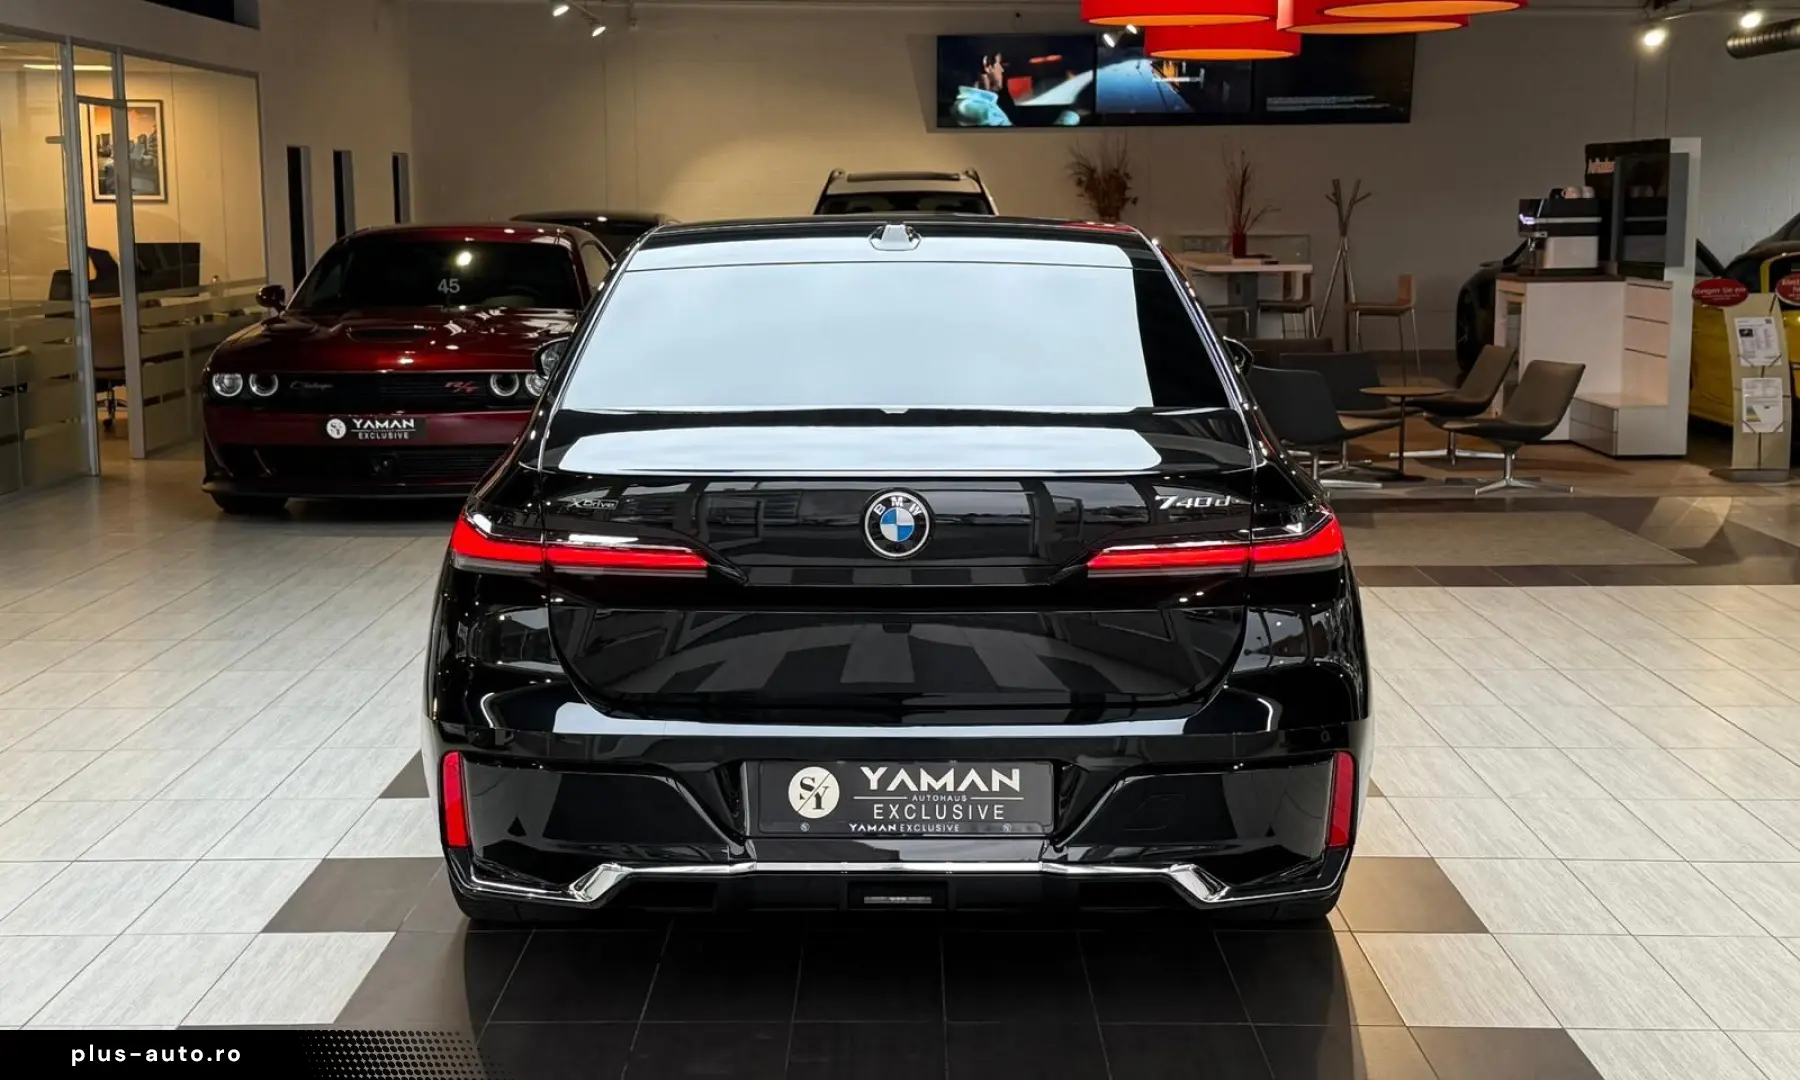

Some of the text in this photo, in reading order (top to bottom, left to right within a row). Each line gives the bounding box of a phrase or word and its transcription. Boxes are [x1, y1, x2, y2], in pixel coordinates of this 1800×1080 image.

[437, 278, 460, 294] 45
[352, 418, 414, 429] YAMAN
[358, 431, 409, 440] EXCLUSIVE
[873, 496, 922, 516] BMW
[1154, 495, 1231, 509] 740d
[860, 766, 1021, 792] YAMAN
[873, 804, 1005, 820] EXCLUSIVE
[849, 823, 960, 832] YAMAN EXCLUSIVE
